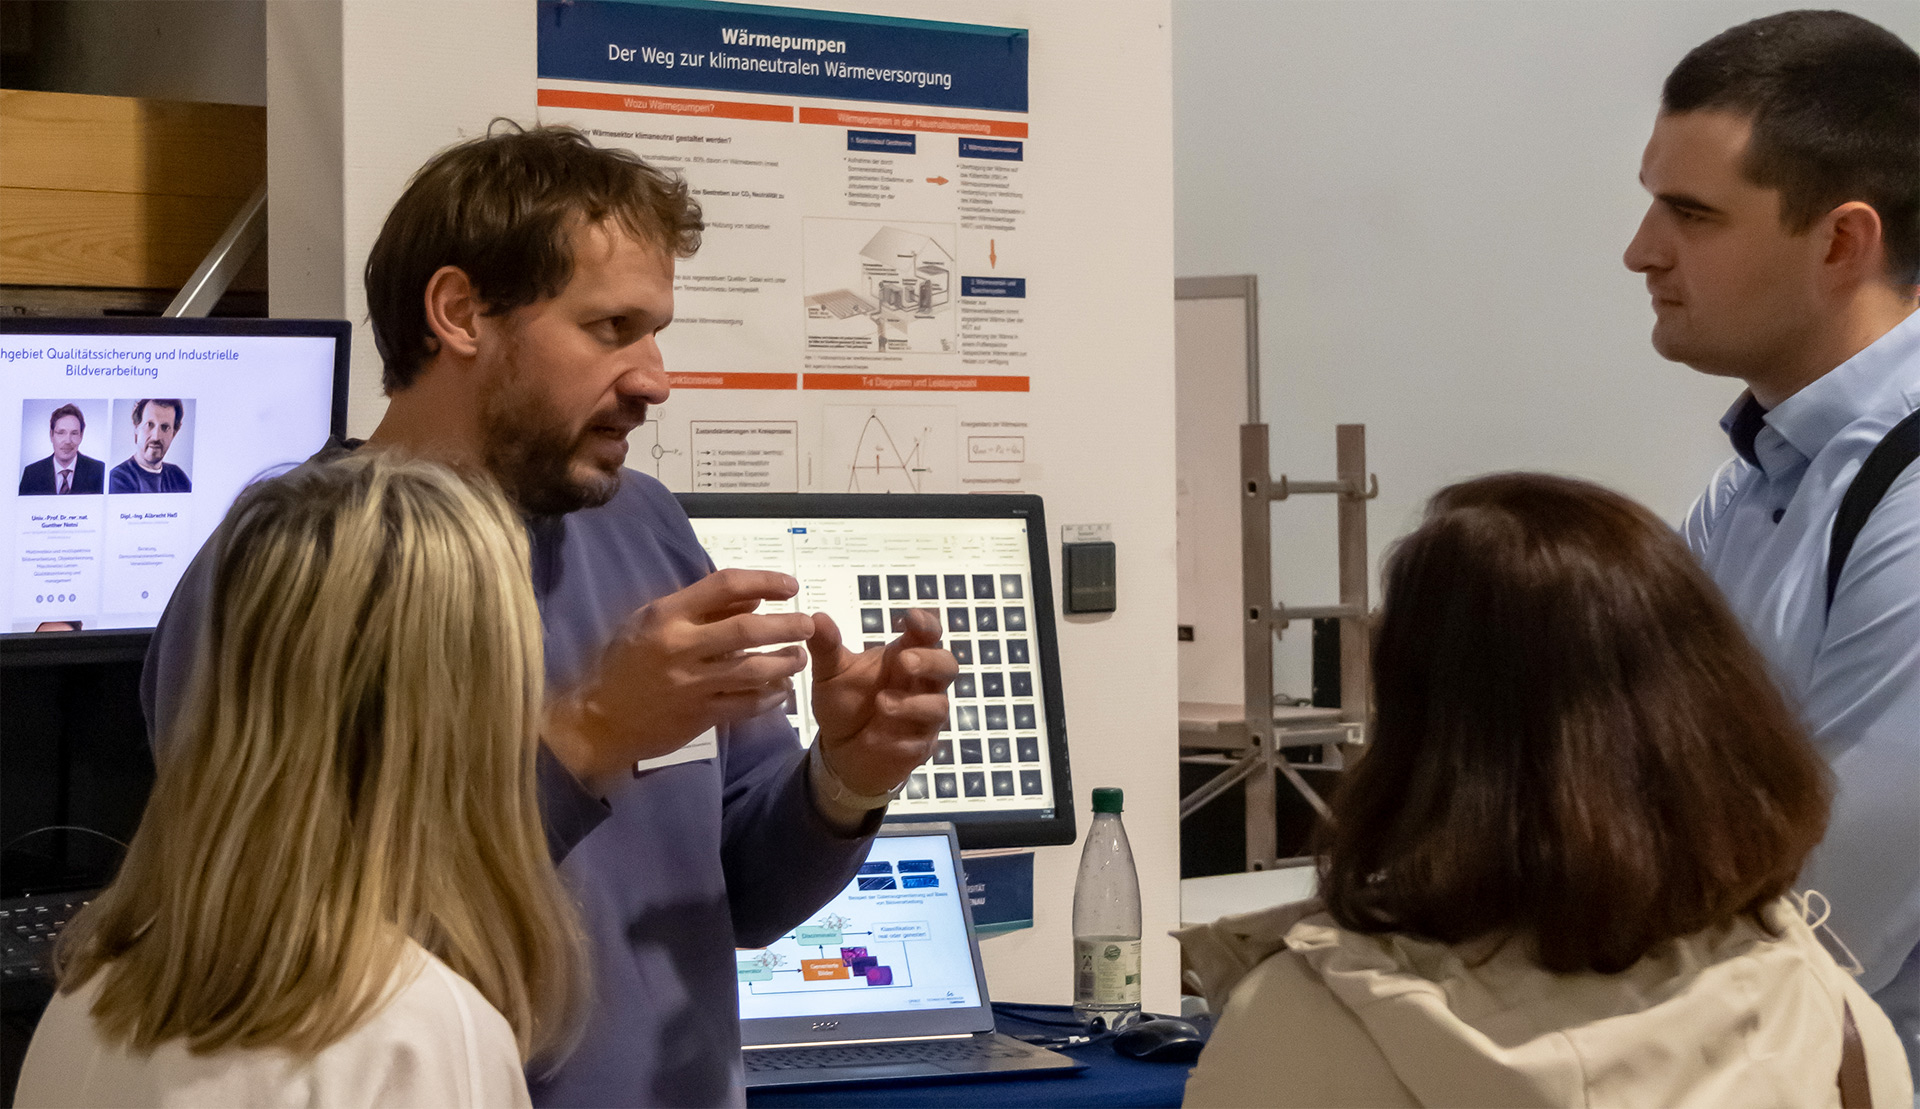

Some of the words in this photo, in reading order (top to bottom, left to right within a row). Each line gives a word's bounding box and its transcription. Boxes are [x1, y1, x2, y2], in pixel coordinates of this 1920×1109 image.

[722, 28, 846, 55] Wärmepumpen
[608, 44, 637, 62] Der
[641, 46, 675, 69] Weg
[680, 53, 705, 67] zur
[709, 51, 820, 76] klimaneutralen
[824, 60, 952, 90] Wärmeversorgung
[623, 97, 648, 109] Wozu
[649, 99, 715, 113] Wärmepumpen?
[901, 117, 915, 127] der
[0, 348, 44, 363] hgebiet
[46, 347, 152, 363] Qualitätssicherung
[154, 349, 176, 360] und
[178, 348, 240, 361] Industrielle
[65, 364, 159, 379] Bildverarbeitung
